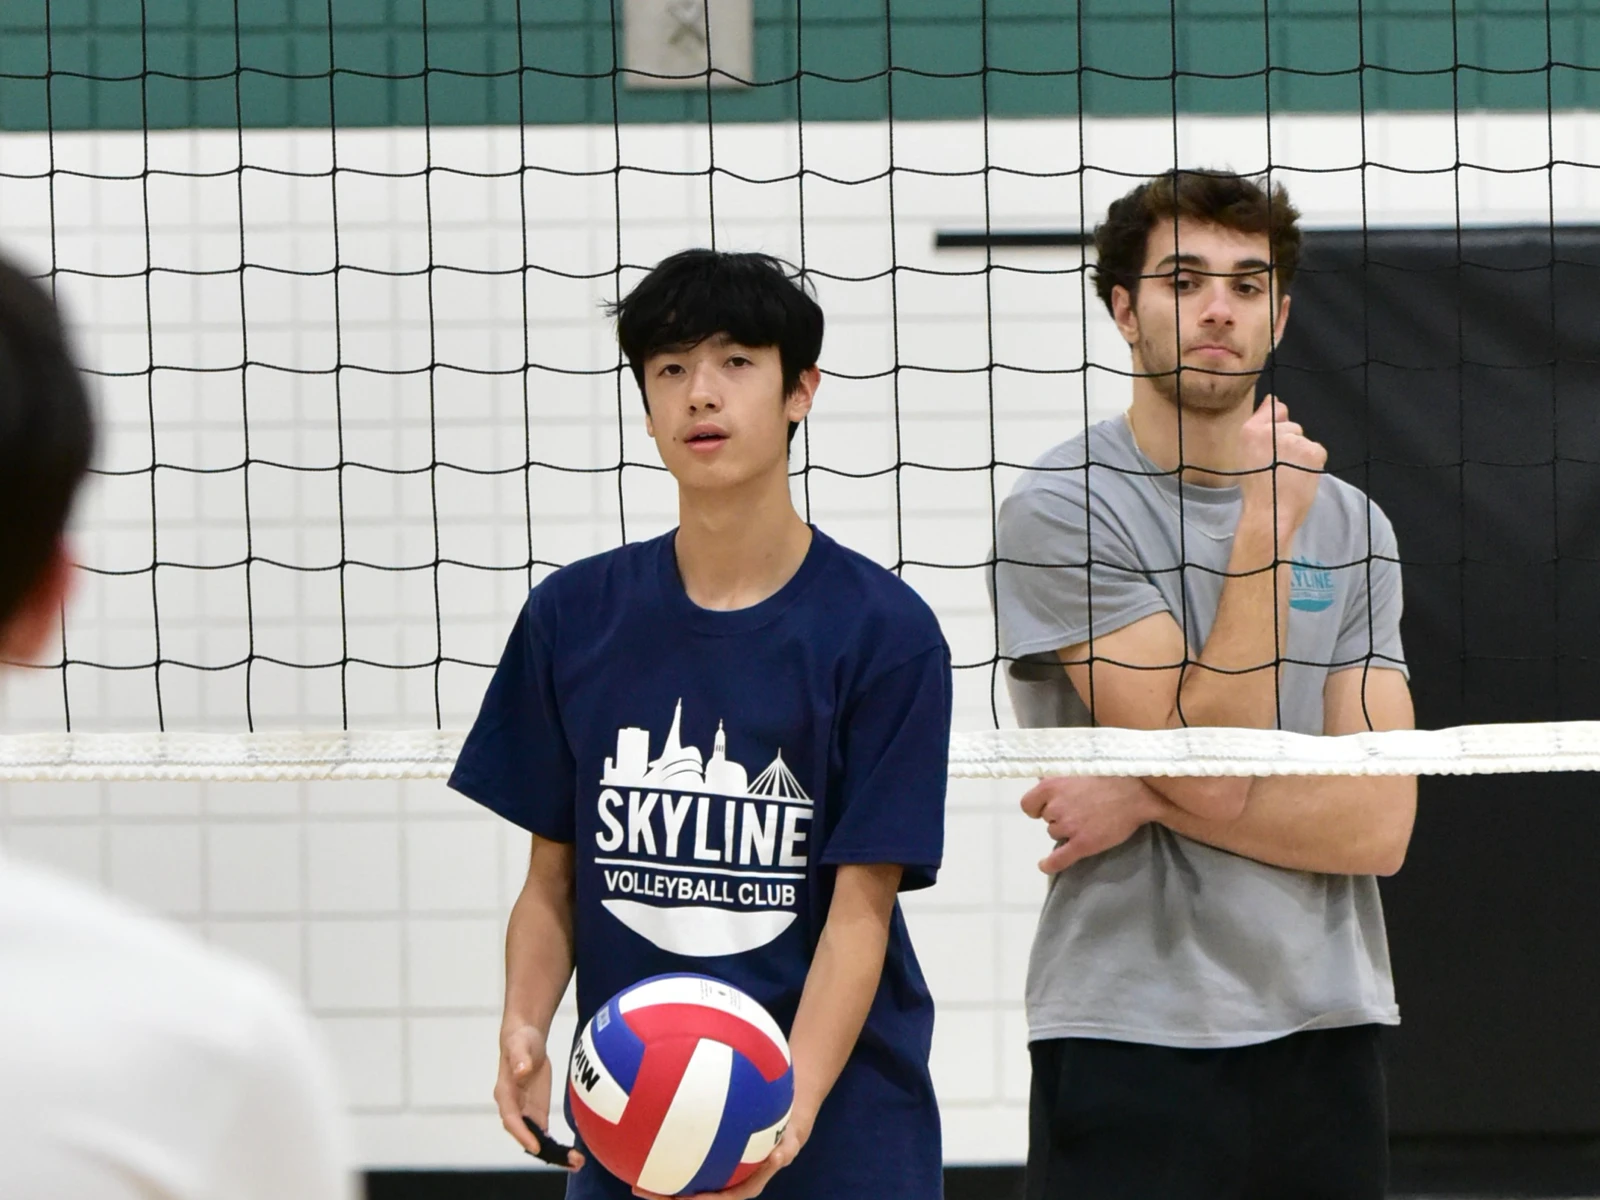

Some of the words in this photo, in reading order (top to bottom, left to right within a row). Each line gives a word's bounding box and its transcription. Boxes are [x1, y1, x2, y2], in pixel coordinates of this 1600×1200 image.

[595, 788, 814, 867] SKYLINE
[604, 869, 734, 903] VOLLEYBALL
[738, 882, 796, 906] CLUB
